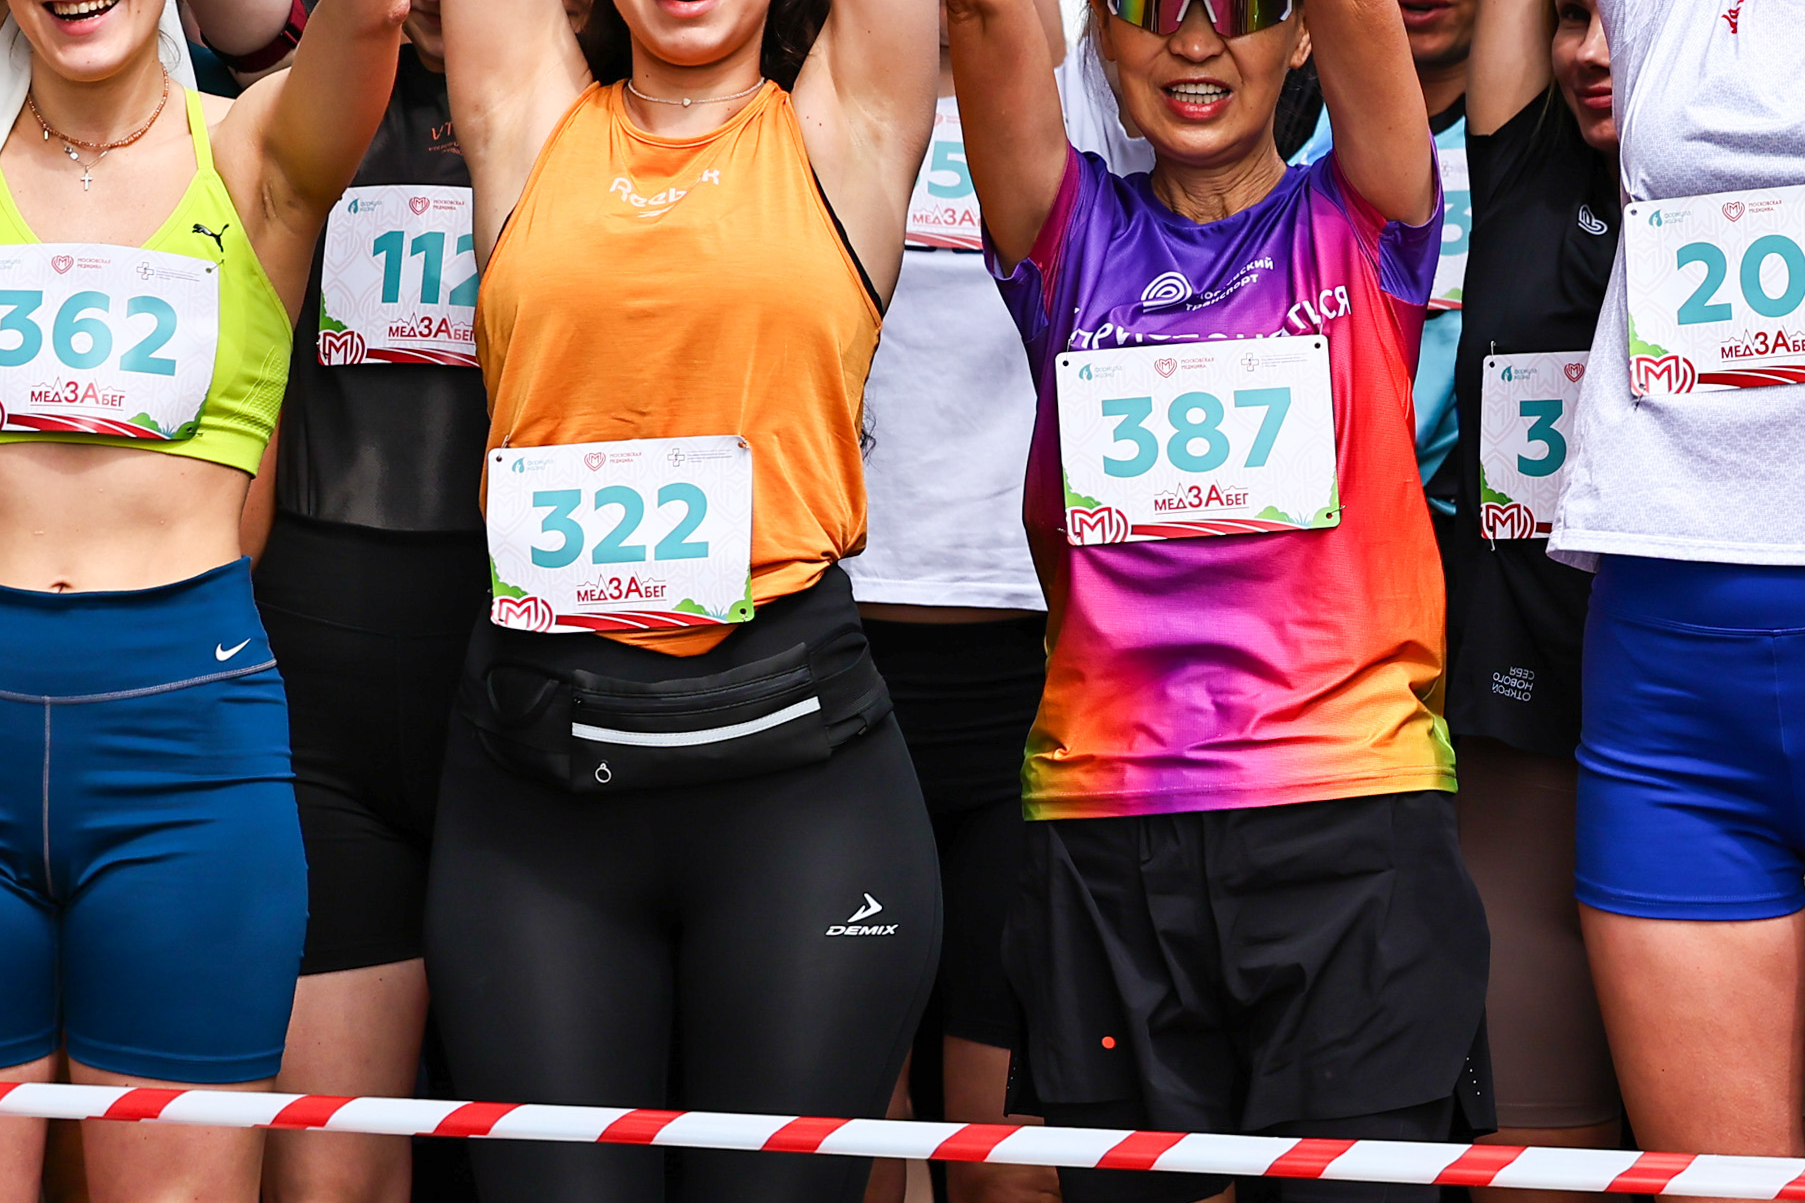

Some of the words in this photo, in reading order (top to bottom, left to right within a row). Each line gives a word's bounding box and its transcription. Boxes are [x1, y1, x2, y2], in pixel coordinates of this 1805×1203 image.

[609, 169, 720, 207] Reebk
[915, 141, 974, 199] 5
[912, 208, 981, 227] МЕДЗА
[0, 290, 178, 377] 362
[1101, 386, 1292, 478] 387
[1517, 399, 1567, 478] 3
[530, 482, 709, 569] 322
[1491, 682, 1532, 702] ОТКРОЙ
[1492, 672, 1534, 691] НОВОГО
[1509, 666, 1535, 681] СЕБЯ
[825, 924, 899, 936] DEMIX
